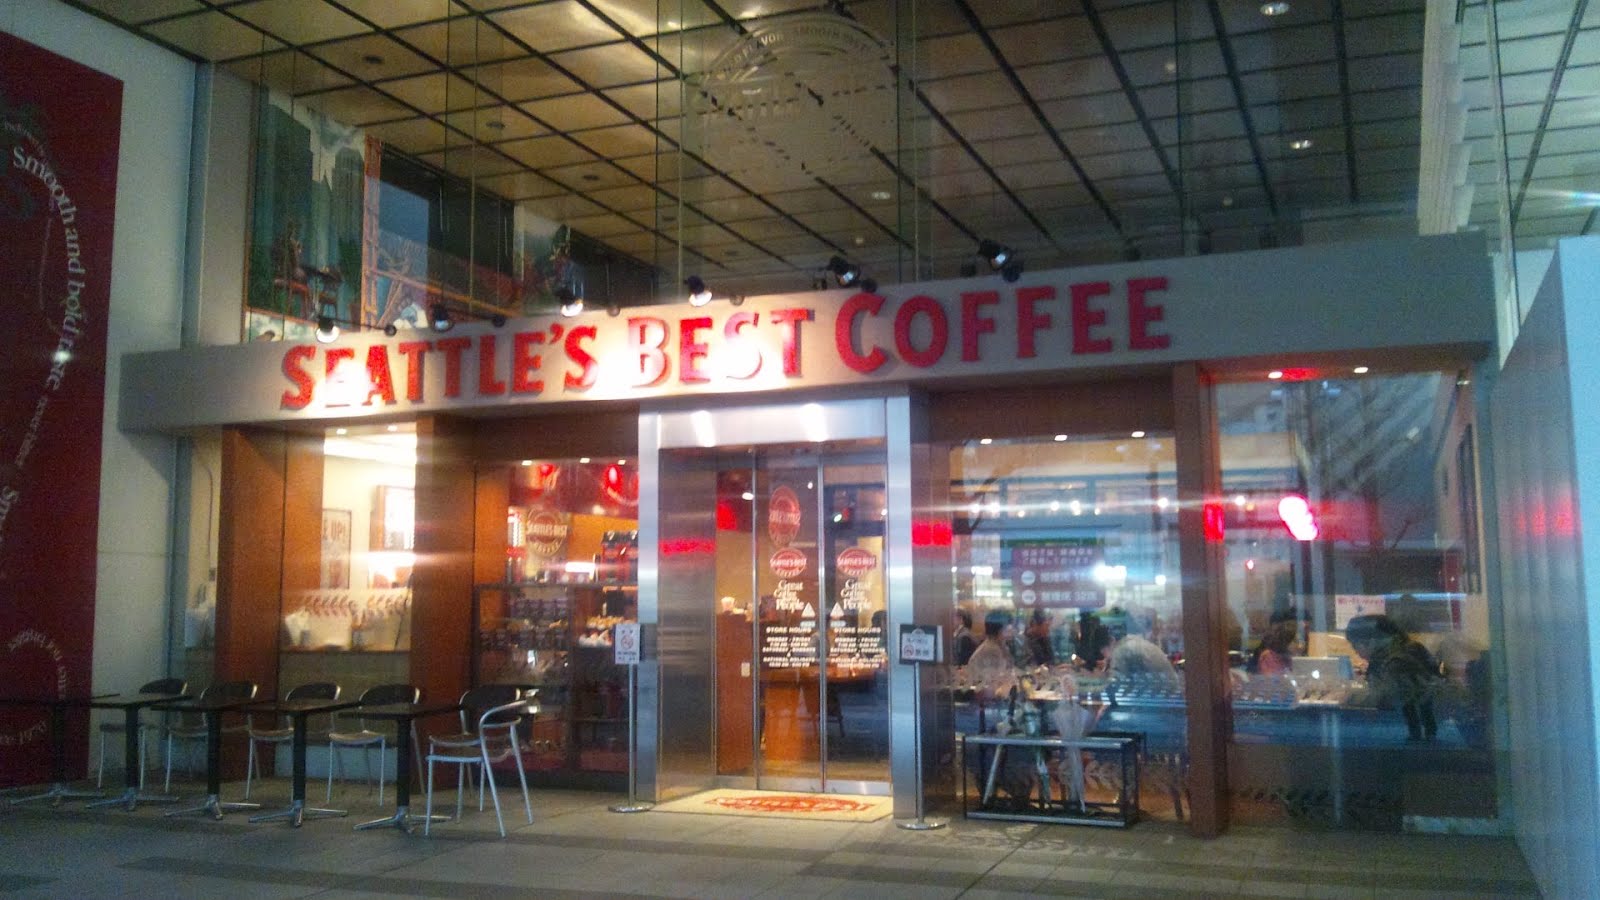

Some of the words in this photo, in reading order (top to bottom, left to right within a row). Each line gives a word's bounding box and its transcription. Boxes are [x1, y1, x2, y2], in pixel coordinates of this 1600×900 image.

[13, 146, 77, 225] Smooth
[64, 227, 86, 273] and
[62, 280, 86, 335] bold
[280, 322, 598, 410] SEATTLE'S
[627, 308, 814, 388] BEST
[835, 276, 1172, 374] COFFEE
